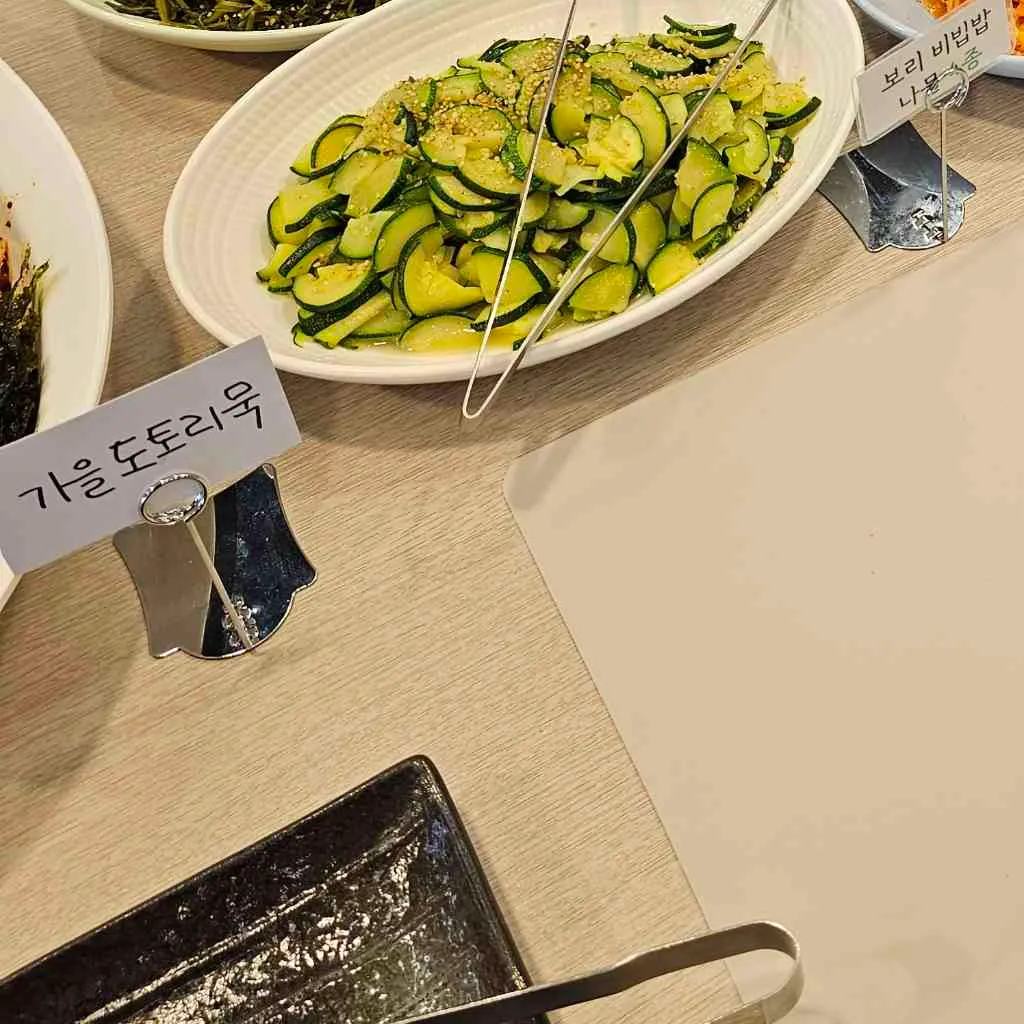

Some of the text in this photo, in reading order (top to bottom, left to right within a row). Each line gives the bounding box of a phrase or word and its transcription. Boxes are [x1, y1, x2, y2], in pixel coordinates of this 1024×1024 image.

[881, 50, 924, 93] 보리
[18, 381, 263, 509] 가을 도토리묵
